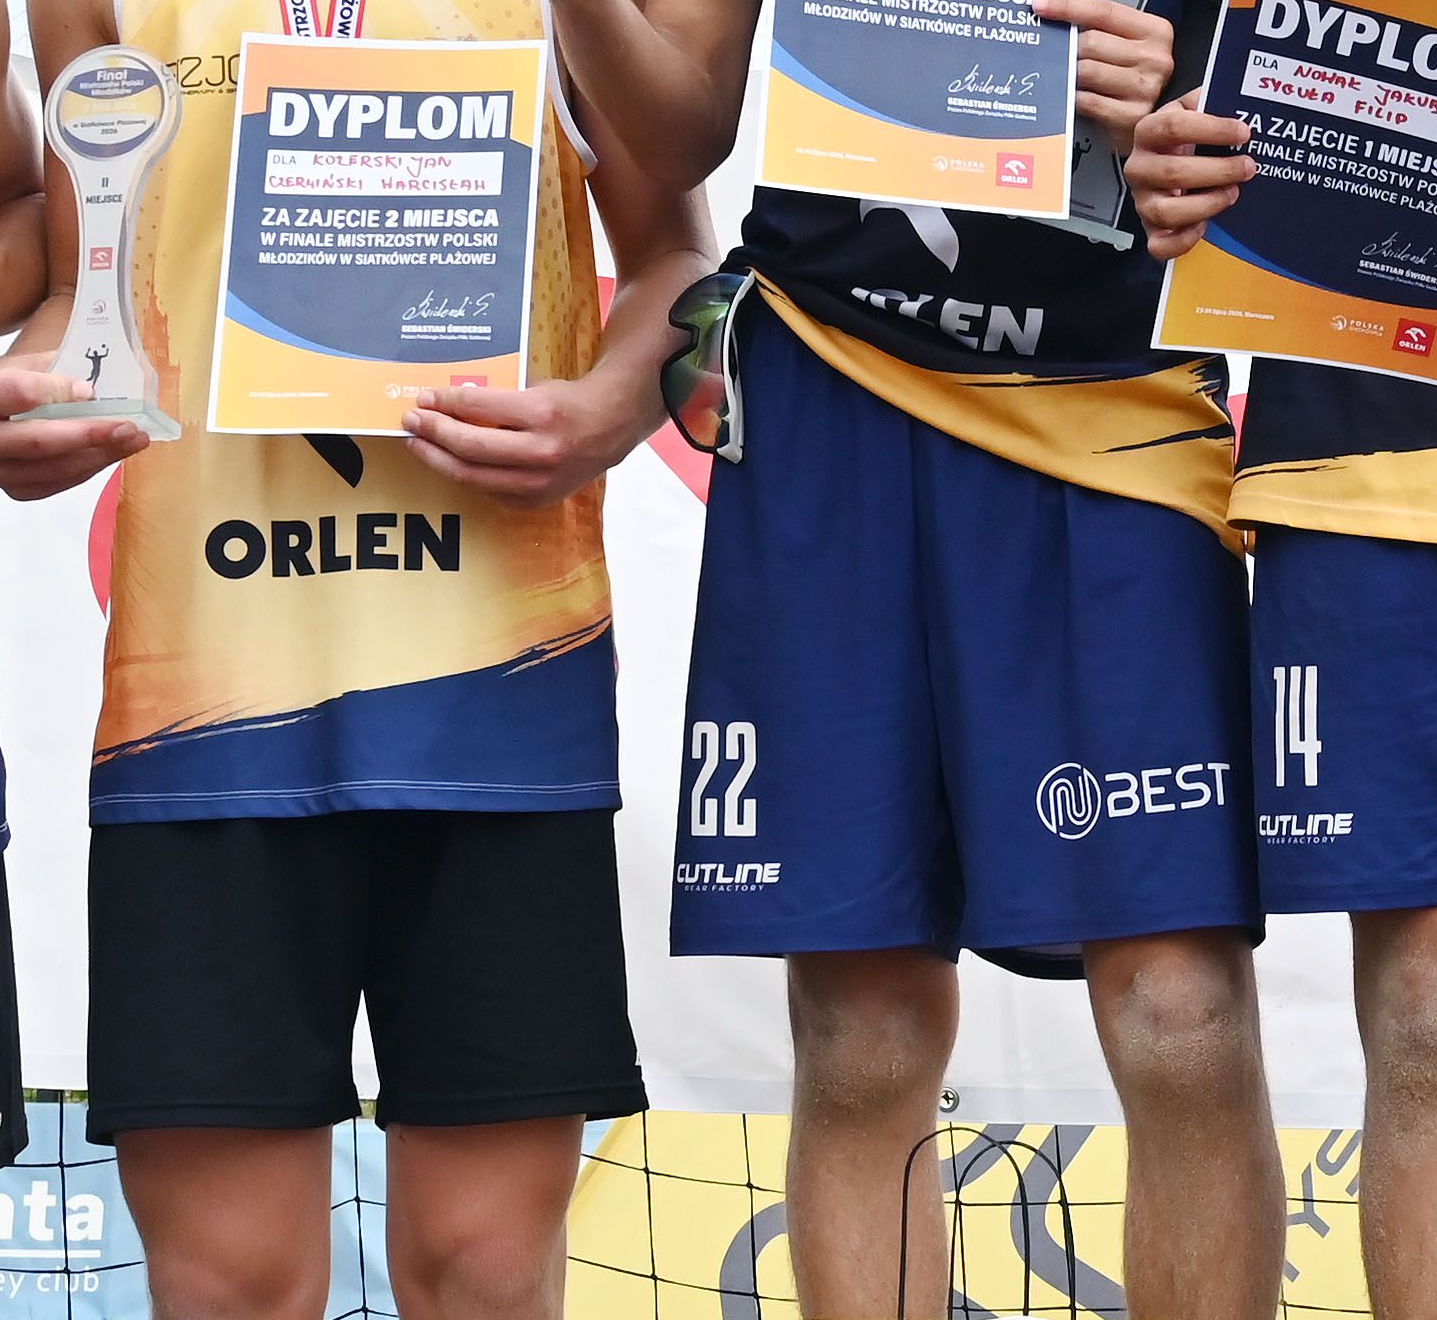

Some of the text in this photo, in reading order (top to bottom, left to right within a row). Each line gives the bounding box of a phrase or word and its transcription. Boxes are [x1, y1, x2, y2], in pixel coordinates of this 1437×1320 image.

[803, 1, 1040, 46] MŁODZIKÓW W SIATKÓWCE PLAŻOWEJ
[986, 6, 1041, 27] POLSKI
[1252, 54, 1279, 70] DLA
[268, 89, 508, 142] DYPLOM
[1353, 100, 1410, 126] FILIP
[1266, 116, 1359, 156] ZAJĘCIE
[1362, 139, 1374, 157] 1
[272, 154, 296, 165] DLA
[406, 155, 451, 178] JAN
[1247, 139, 1304, 163] FINALE
[1305, 152, 1414, 189] MISTRZOSTW
[1306, 173, 1320, 186] W
[1321, 174, 1399, 204] SIATKÓWCE
[261, 207, 499, 230] ZA ZAJĘCIE 2 MIEJSCA
[260, 230, 498, 249] W FINALE MISTRZOSTW POLSKI
[258, 250, 496, 266] MŁODZIKÓW W SIATKÓWCE PLAŻOWEJ
[205, 512, 461, 580] ORLEN
[1273, 665, 1322, 787] 14
[691, 721, 757, 838] 22
[1105, 762, 1231, 818] BEST
[676, 862, 782, 886] CUTLINE
[36, 1265, 100, 1293] club
